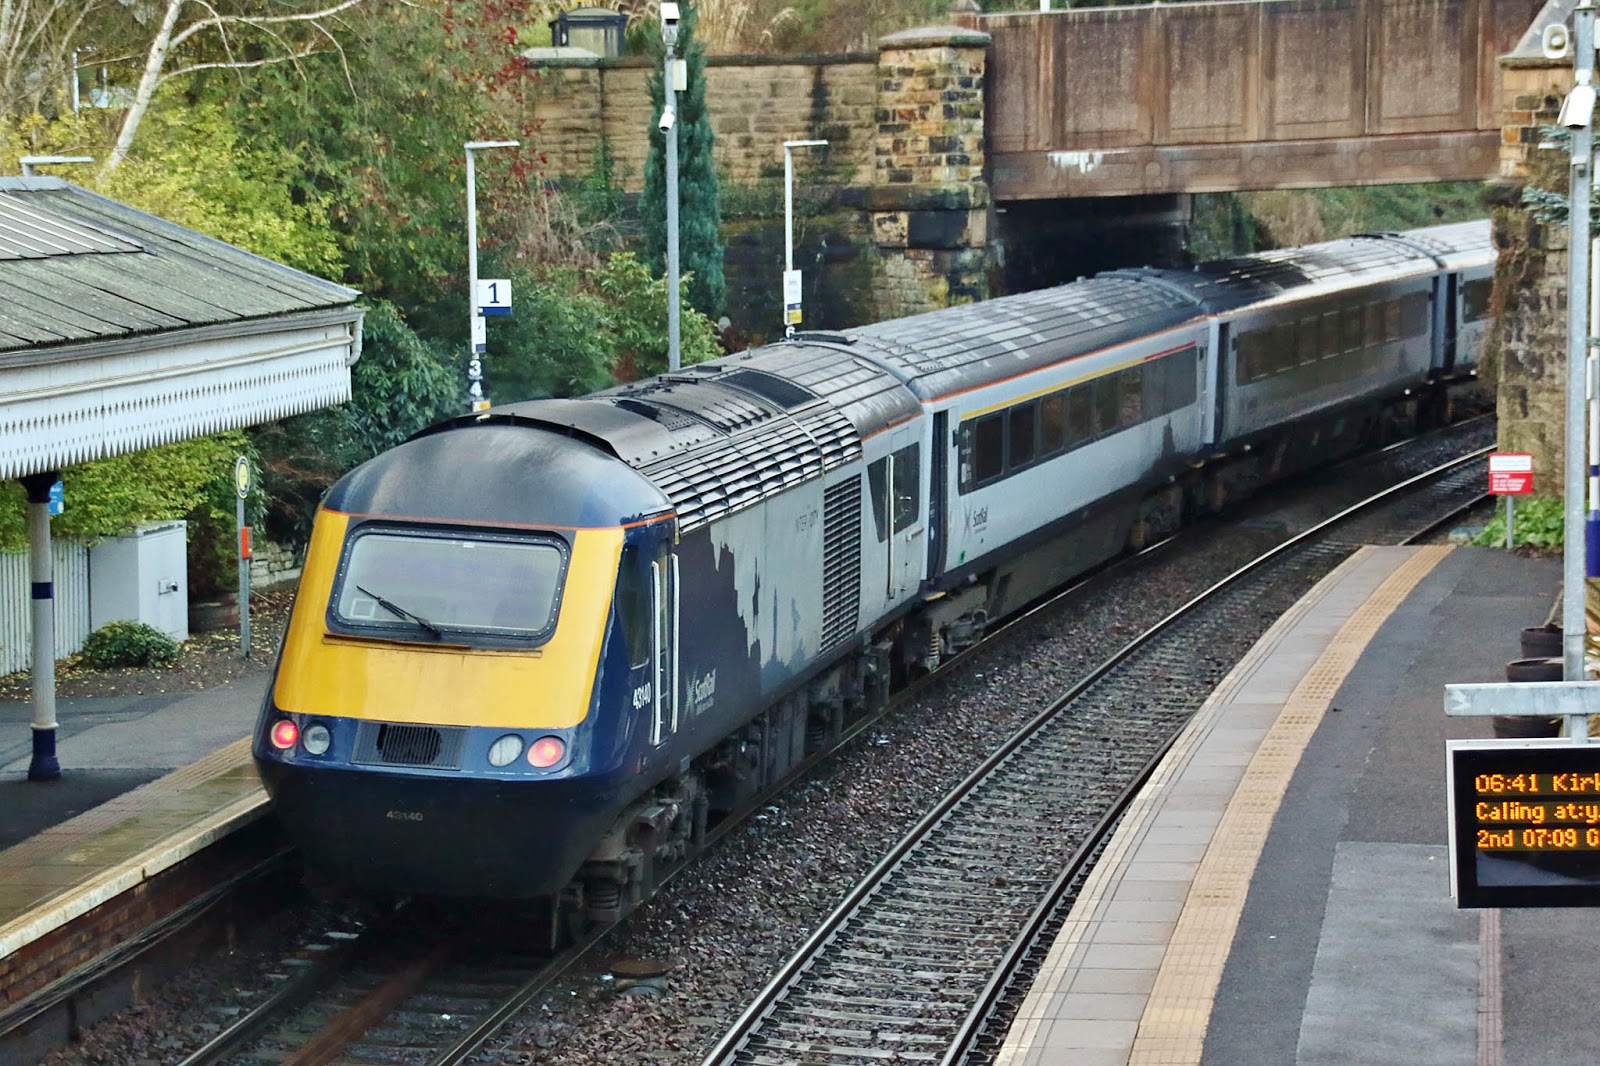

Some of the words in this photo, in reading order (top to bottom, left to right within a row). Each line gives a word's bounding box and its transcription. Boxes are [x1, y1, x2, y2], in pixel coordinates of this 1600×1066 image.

[488, 282, 500, 304] 1
[468, 359, 481, 377] 3
[632, 681, 652, 710] 43140
[1475, 773, 1539, 793] 06:41
[1475, 801, 1546, 824] Calling
[1554, 803, 1600, 824] at:y
[1476, 829, 1515, 849] 2nd
[1522, 828, 1579, 848] 07:09
